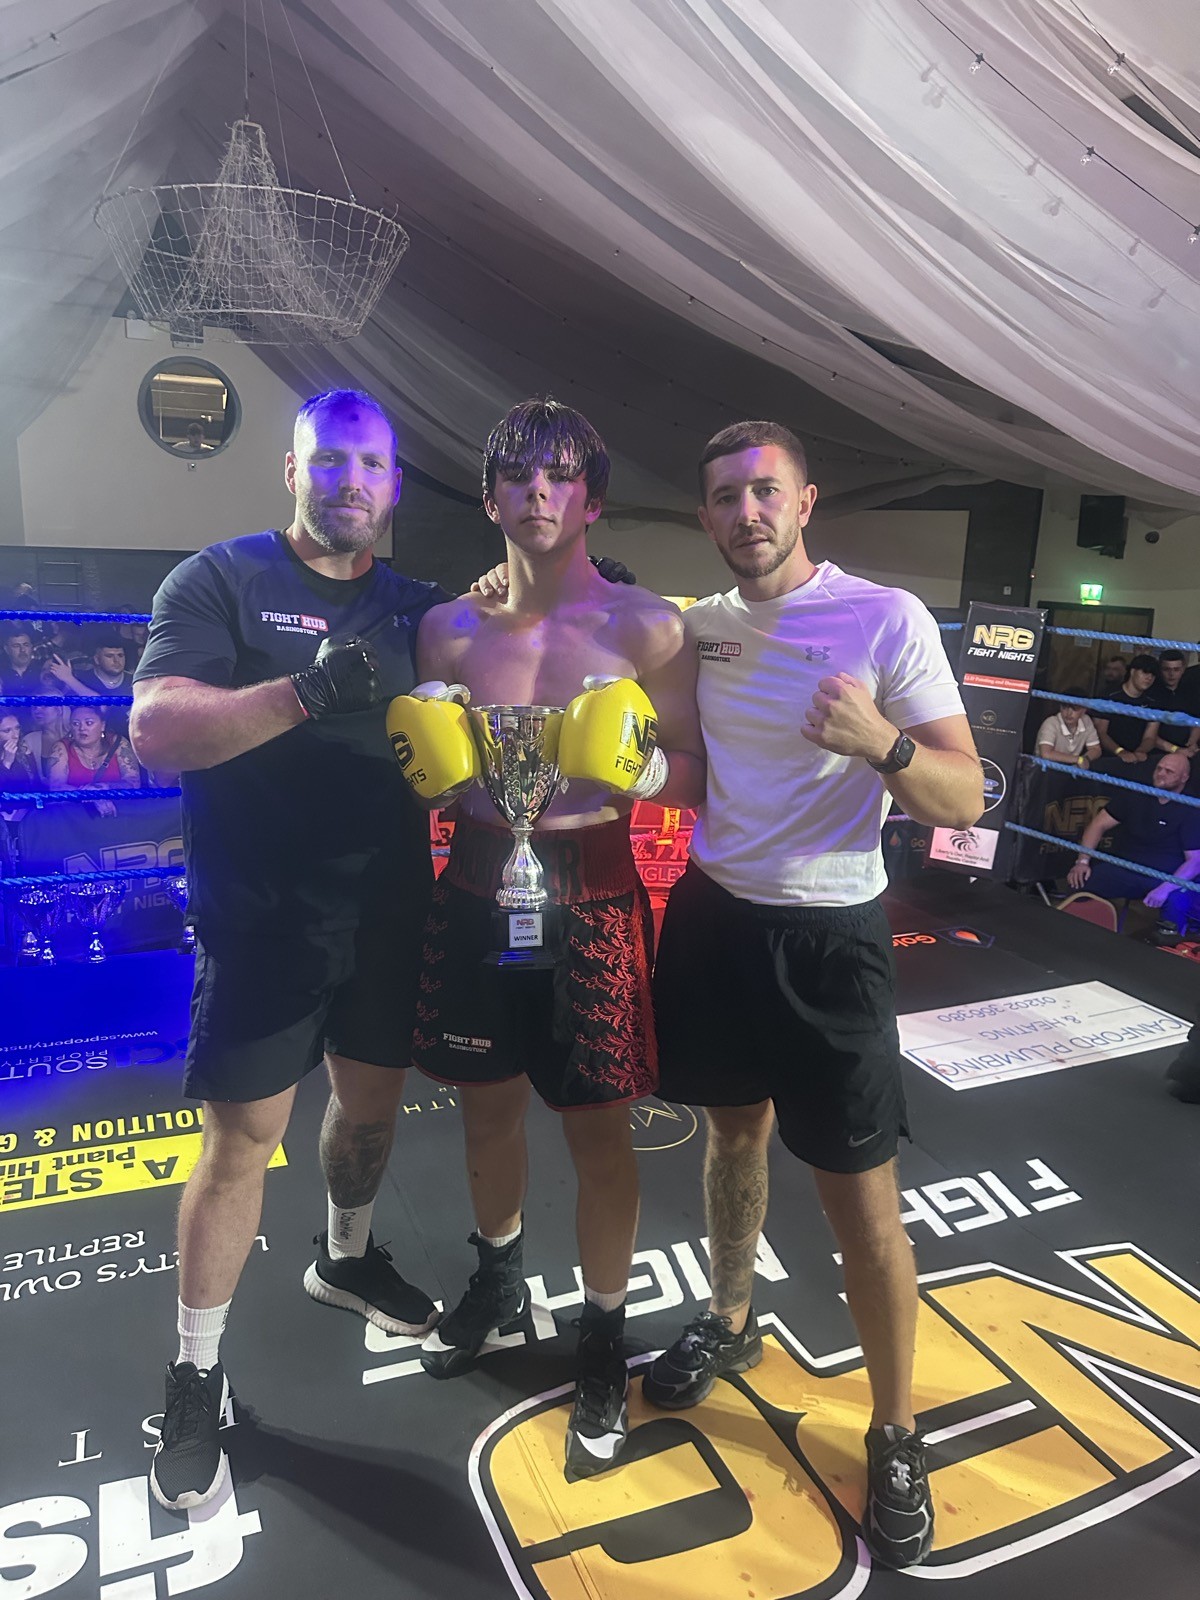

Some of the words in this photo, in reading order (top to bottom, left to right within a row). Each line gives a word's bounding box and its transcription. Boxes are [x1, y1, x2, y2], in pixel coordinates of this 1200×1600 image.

[261, 611, 300, 625] FIGHT
[302, 616, 327, 629] HUB
[276, 625, 318, 636] BASINGSTOKE
[697, 641, 720, 653] FIGHT
[721, 643, 740, 655] HUB
[973, 624, 1035, 651] NRG
[967, 647, 997, 658] FIGHT
[998, 651, 1035, 663] NIGHTS
[937, 1001, 999, 1023] 366380
[1004, 996, 1056, 1011] 01202
[977, 1017, 1064, 1041] HEATING
[1064, 1014, 1081, 1025] &
[443, 1033, 469, 1045] FIGHT
[471, 1038, 492, 1048] HUB
[1068, 1018, 1183, 1051] CANFORD
[1, 1049, 108, 1068] PROPERTY
[934, 1039, 1071, 1076] PLUMBING
[0, 1056, 108, 1081] SOUT
[33, 1127, 57, 1147] &
[52, 1146, 136, 1171] Plant
[0, 1168, 103, 1206] STE
[2, 1230, 146, 1272] REPTILE
